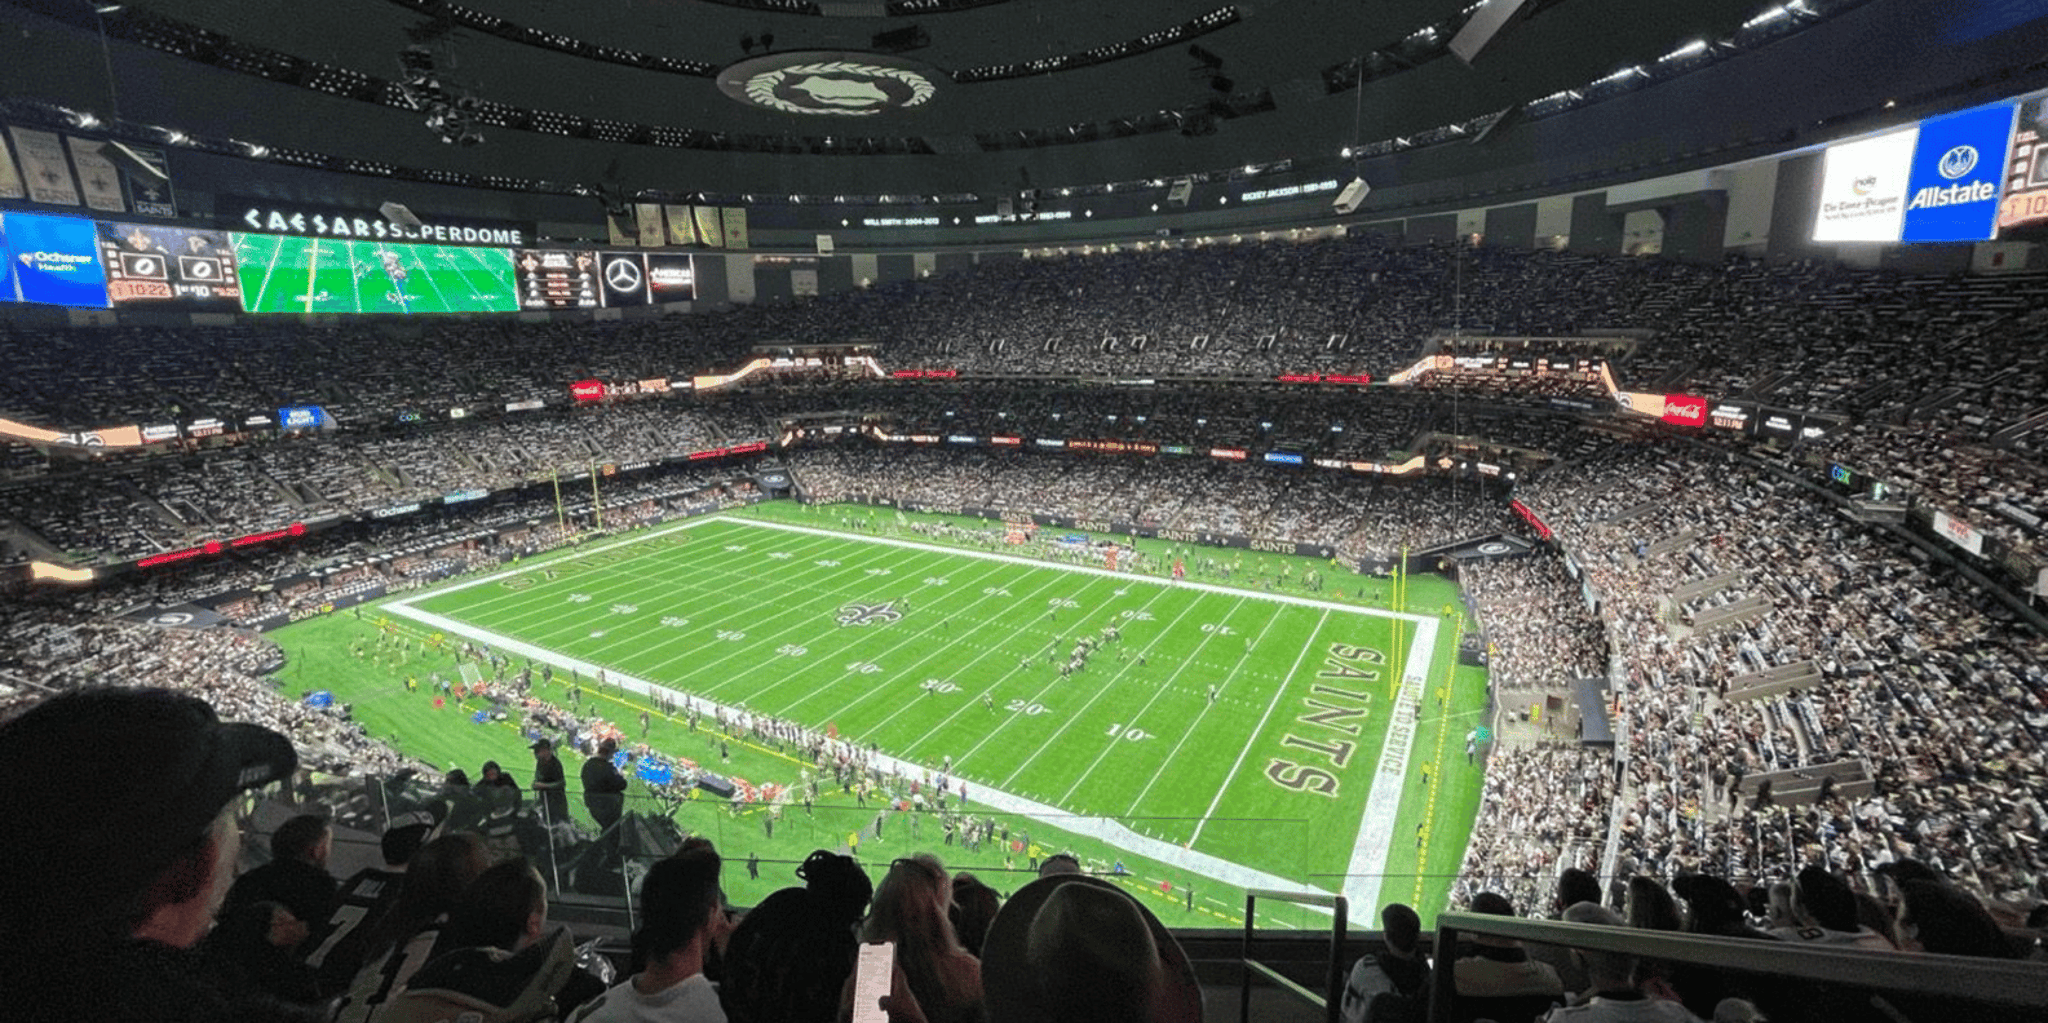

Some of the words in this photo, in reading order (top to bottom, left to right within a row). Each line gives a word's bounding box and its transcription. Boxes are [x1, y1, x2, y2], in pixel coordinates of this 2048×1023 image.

[1908, 179, 1996, 211] Allstate
[244, 208, 388, 239] CAESARS
[135, 258, 155, 275] 0
[192, 261, 212, 278] 0
[1664, 402, 1702, 420] Coca-Cola
[1075, 519, 1111, 533] SAINTS
[1157, 529, 1198, 542] SAINTS
[1250, 539, 1297, 554] SAINTS
[289, 607, 320, 622] SAIN
[1004, 699, 1045, 715] 20
[1264, 642, 1387, 798] SAINTS
[1105, 723, 1144, 742] 10
[1381, 724, 1411, 776] SERVICE
[305, 904, 369, 969] 7
